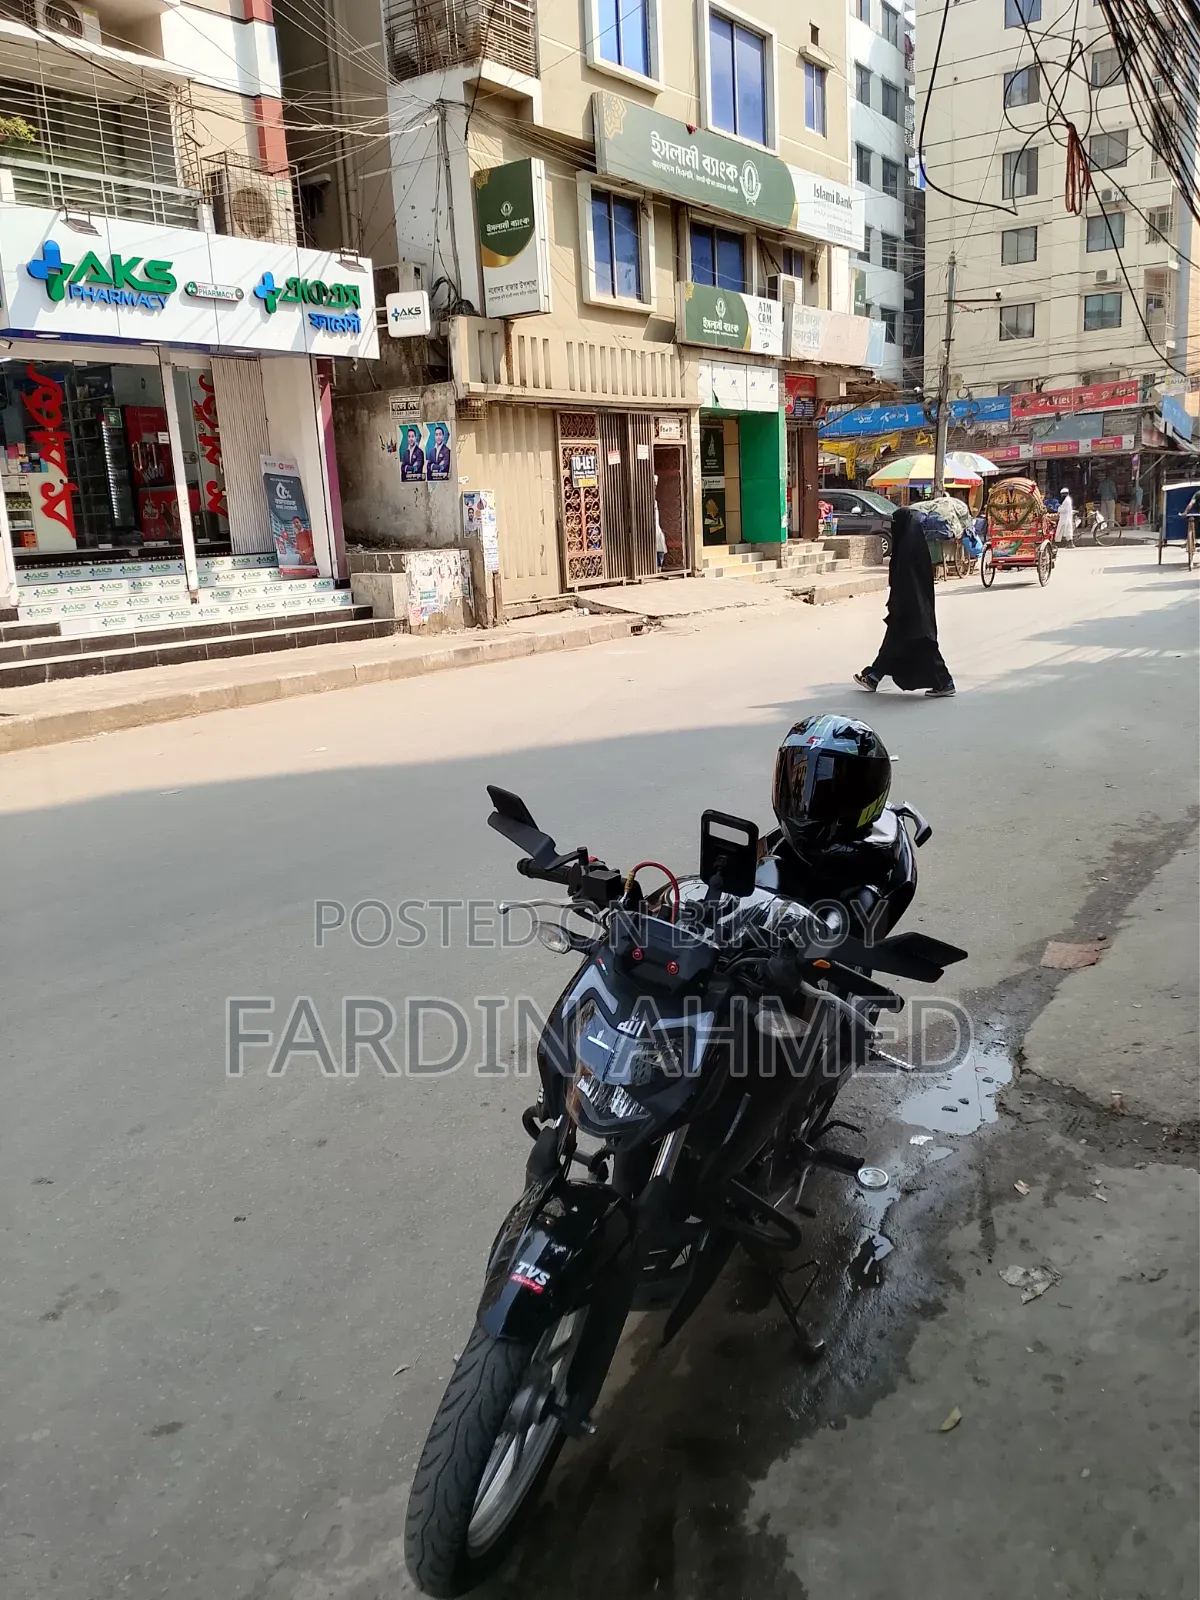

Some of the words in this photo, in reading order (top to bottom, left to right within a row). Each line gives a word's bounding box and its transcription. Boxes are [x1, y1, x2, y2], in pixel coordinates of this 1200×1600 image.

[651, 131, 699, 171] ইসলামী
[702, 154, 738, 183] ব্যাংক
[814, 183, 834, 203] Islami
[836, 192, 852, 210] Bank
[69, 251, 177, 294] AKS
[69, 284, 168, 309] PHARMACY
[198, 288, 234, 298] PHARMACY
[400, 306, 421, 316] AKS
[759, 302, 771, 313] ATM
[703, 317, 723, 331] ইসলামী
[758, 313, 771, 324] CRM
[572, 456, 595, 470] TO-LET
[515, 1261, 551, 1286] TVS
